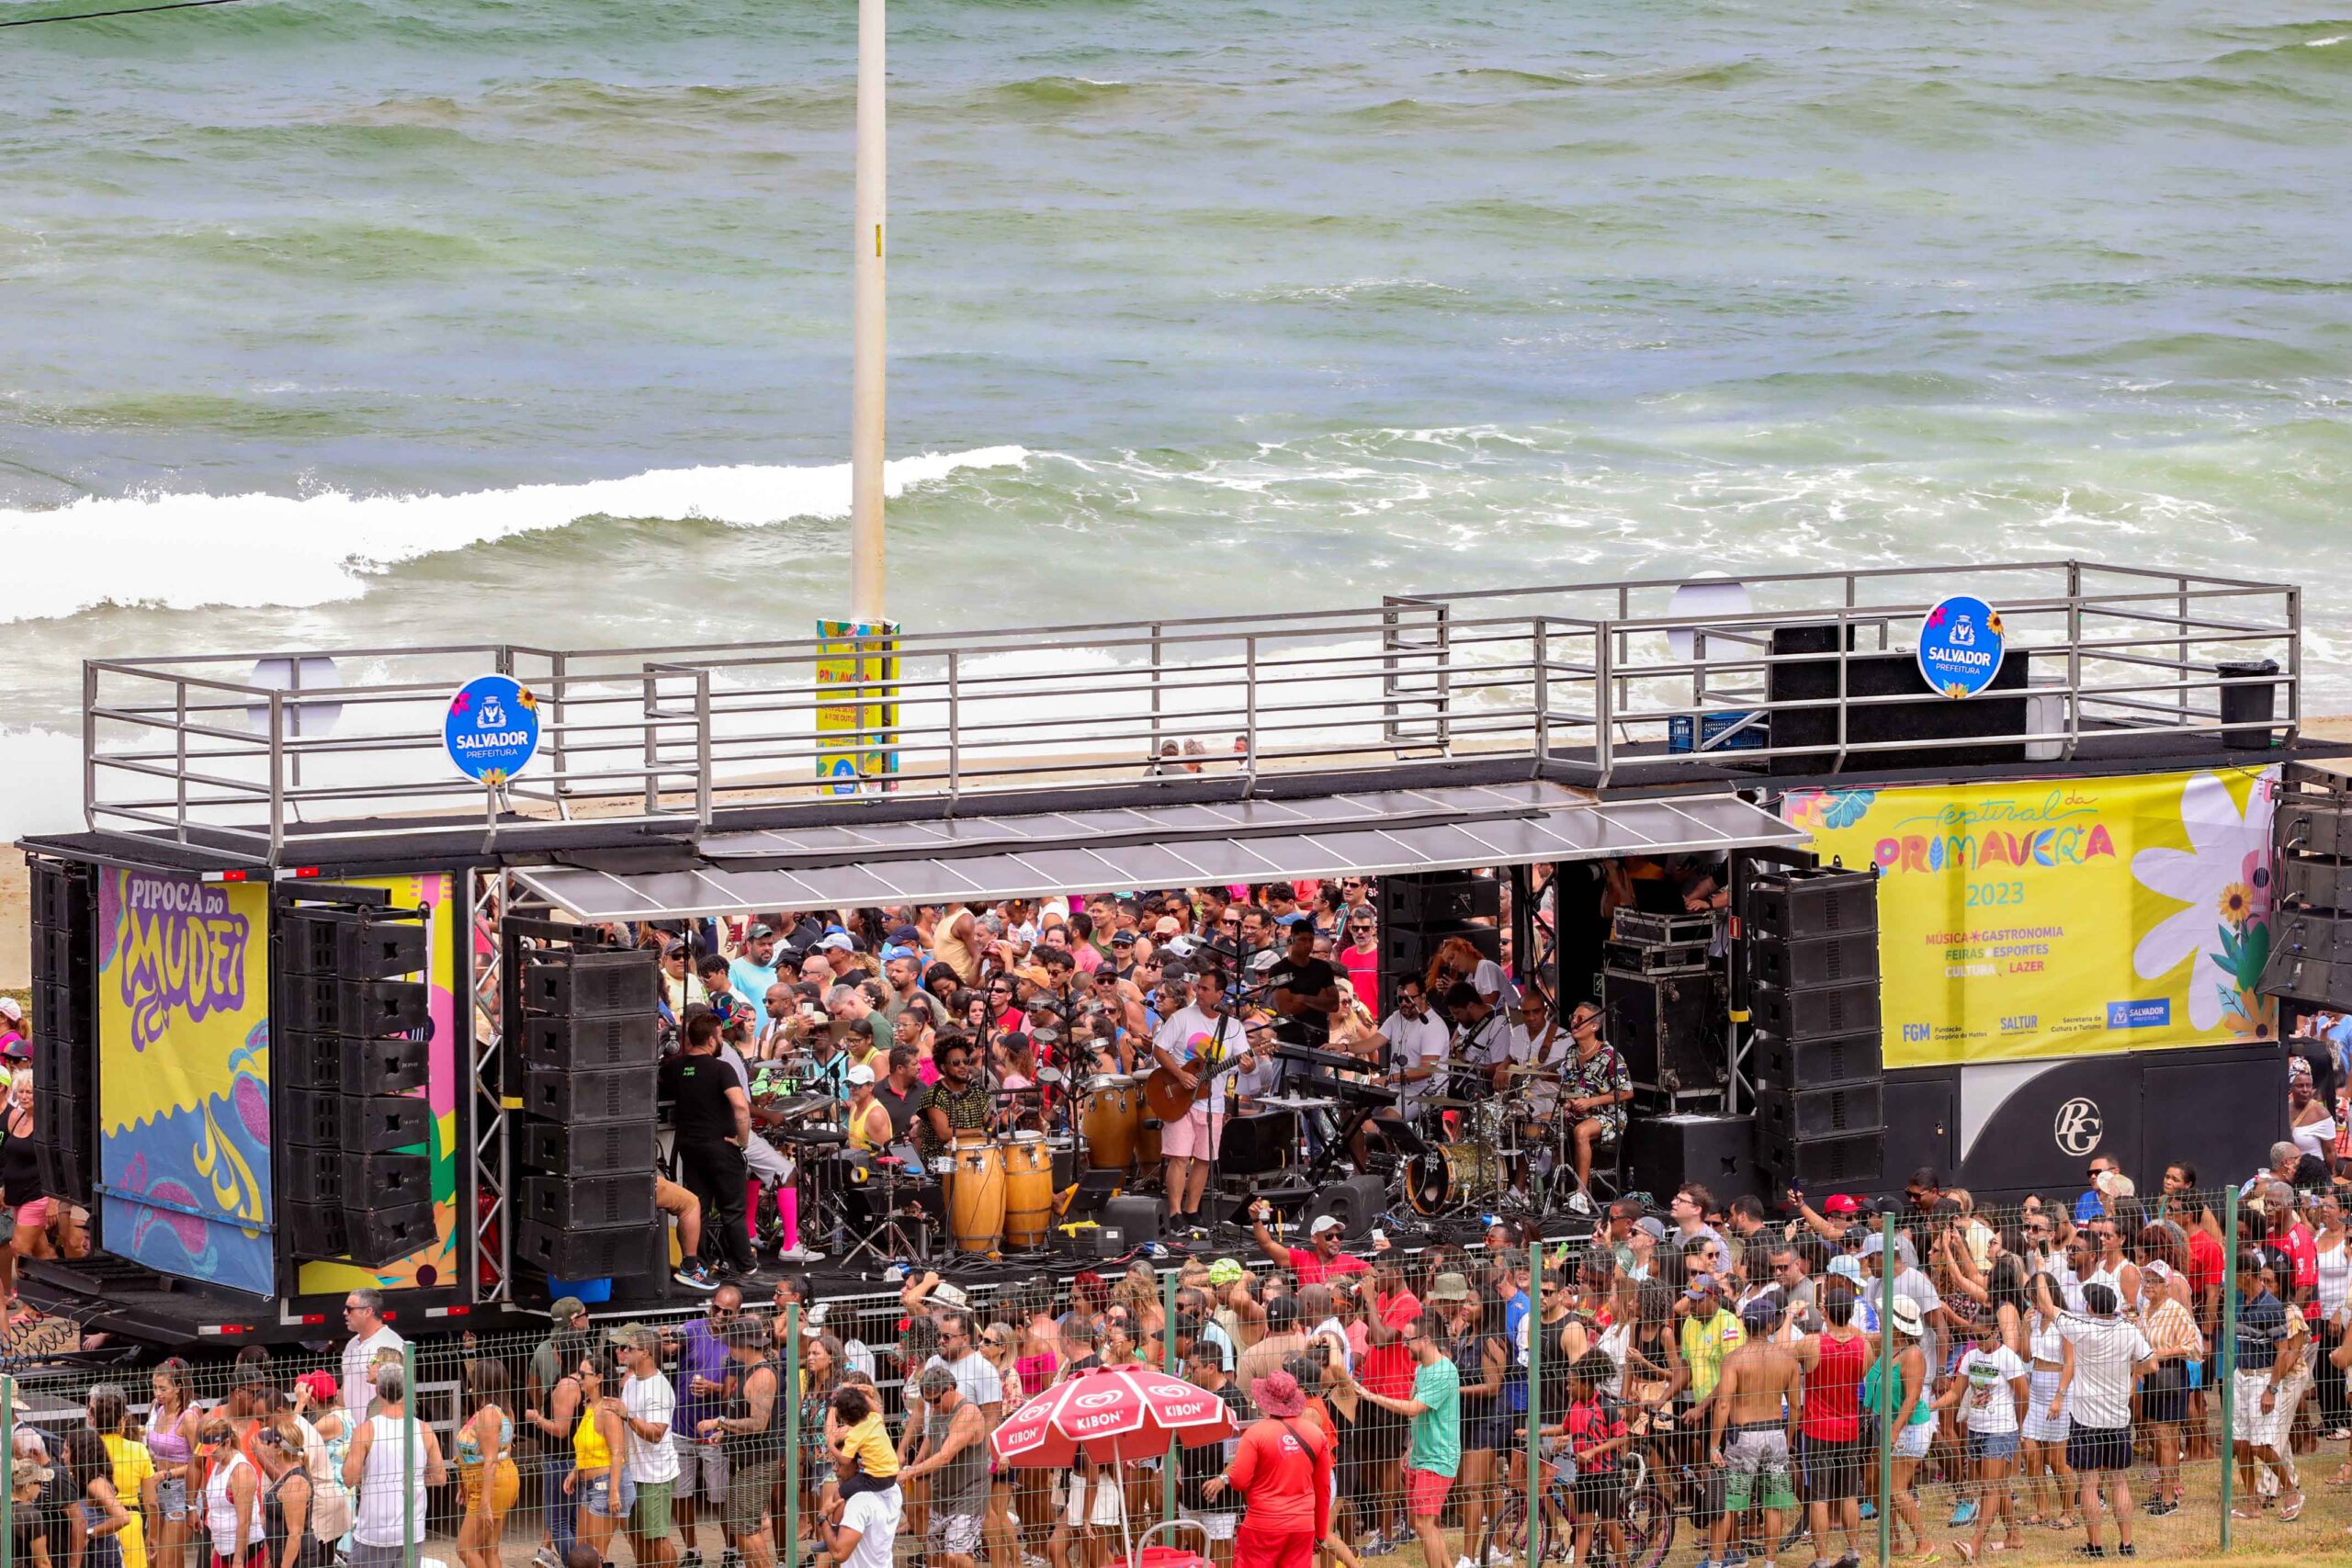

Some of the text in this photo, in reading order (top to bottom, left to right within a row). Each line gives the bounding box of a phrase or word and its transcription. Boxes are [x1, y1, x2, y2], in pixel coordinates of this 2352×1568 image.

[1928, 647, 1991, 667] SALVADOR
[820, 669, 870, 682] PRIMAVEA
[1936, 663, 1980, 675] PREFEITURA
[456, 731, 528, 750] SALVADOR
[466, 749, 518, 759] PREFEITURA
[2064, 789, 2098, 806] da
[1874, 823, 2116, 875] PRIMAVERA
[130, 879, 224, 914] PIPOCA DO
[1966, 882, 2025, 907] 2023
[1926, 926, 2064, 945] MÚSICA GASTRONOMIA
[1945, 943, 2049, 961] FEIRAS ESPORTES
[1945, 961, 2044, 977] CULTURA LAZER
[2129, 1007, 2165, 1017] SALVADOR
[2000, 1014, 2038, 1030] SALTUR
[1903, 1022, 1930, 1042] FGM
[1164, 1403, 1202, 1417] KIBON
[1077, 1411, 1121, 1430] KIBON
[1008, 1429, 1036, 1445] KIBON
